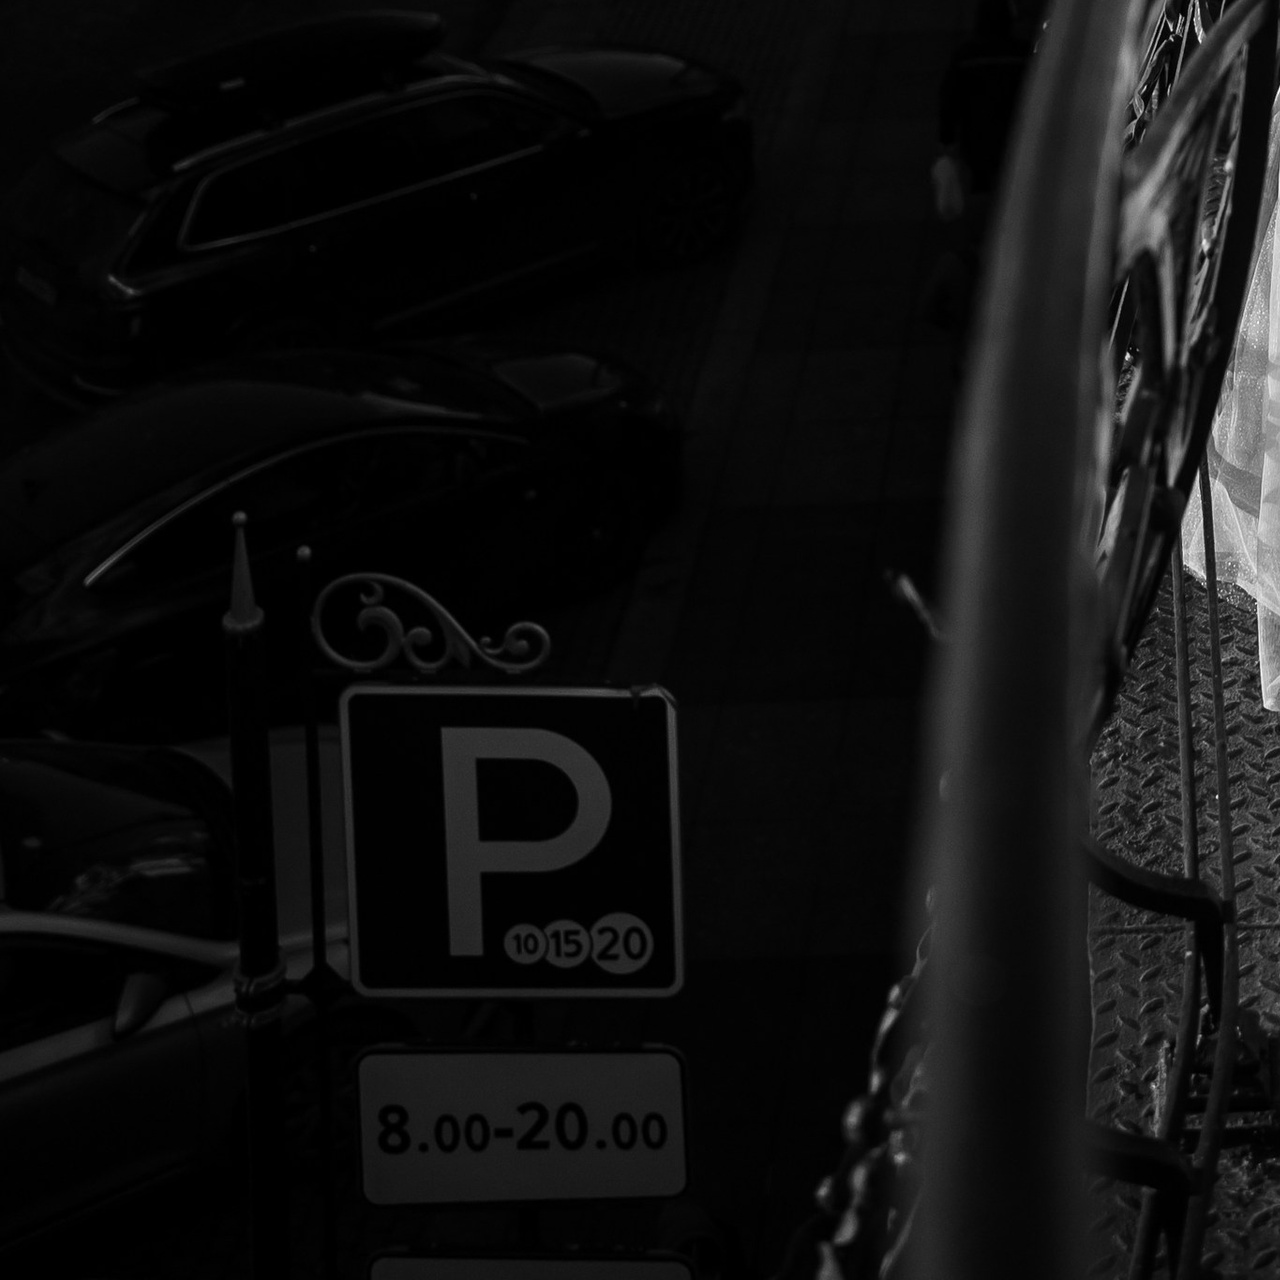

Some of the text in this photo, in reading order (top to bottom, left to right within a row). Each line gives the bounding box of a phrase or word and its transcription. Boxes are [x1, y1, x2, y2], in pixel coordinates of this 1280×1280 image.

[441, 726, 613, 956] P
[512, 926, 649, 962] 10 15 20
[378, 1102, 668, 1155] 8.00-20.00
